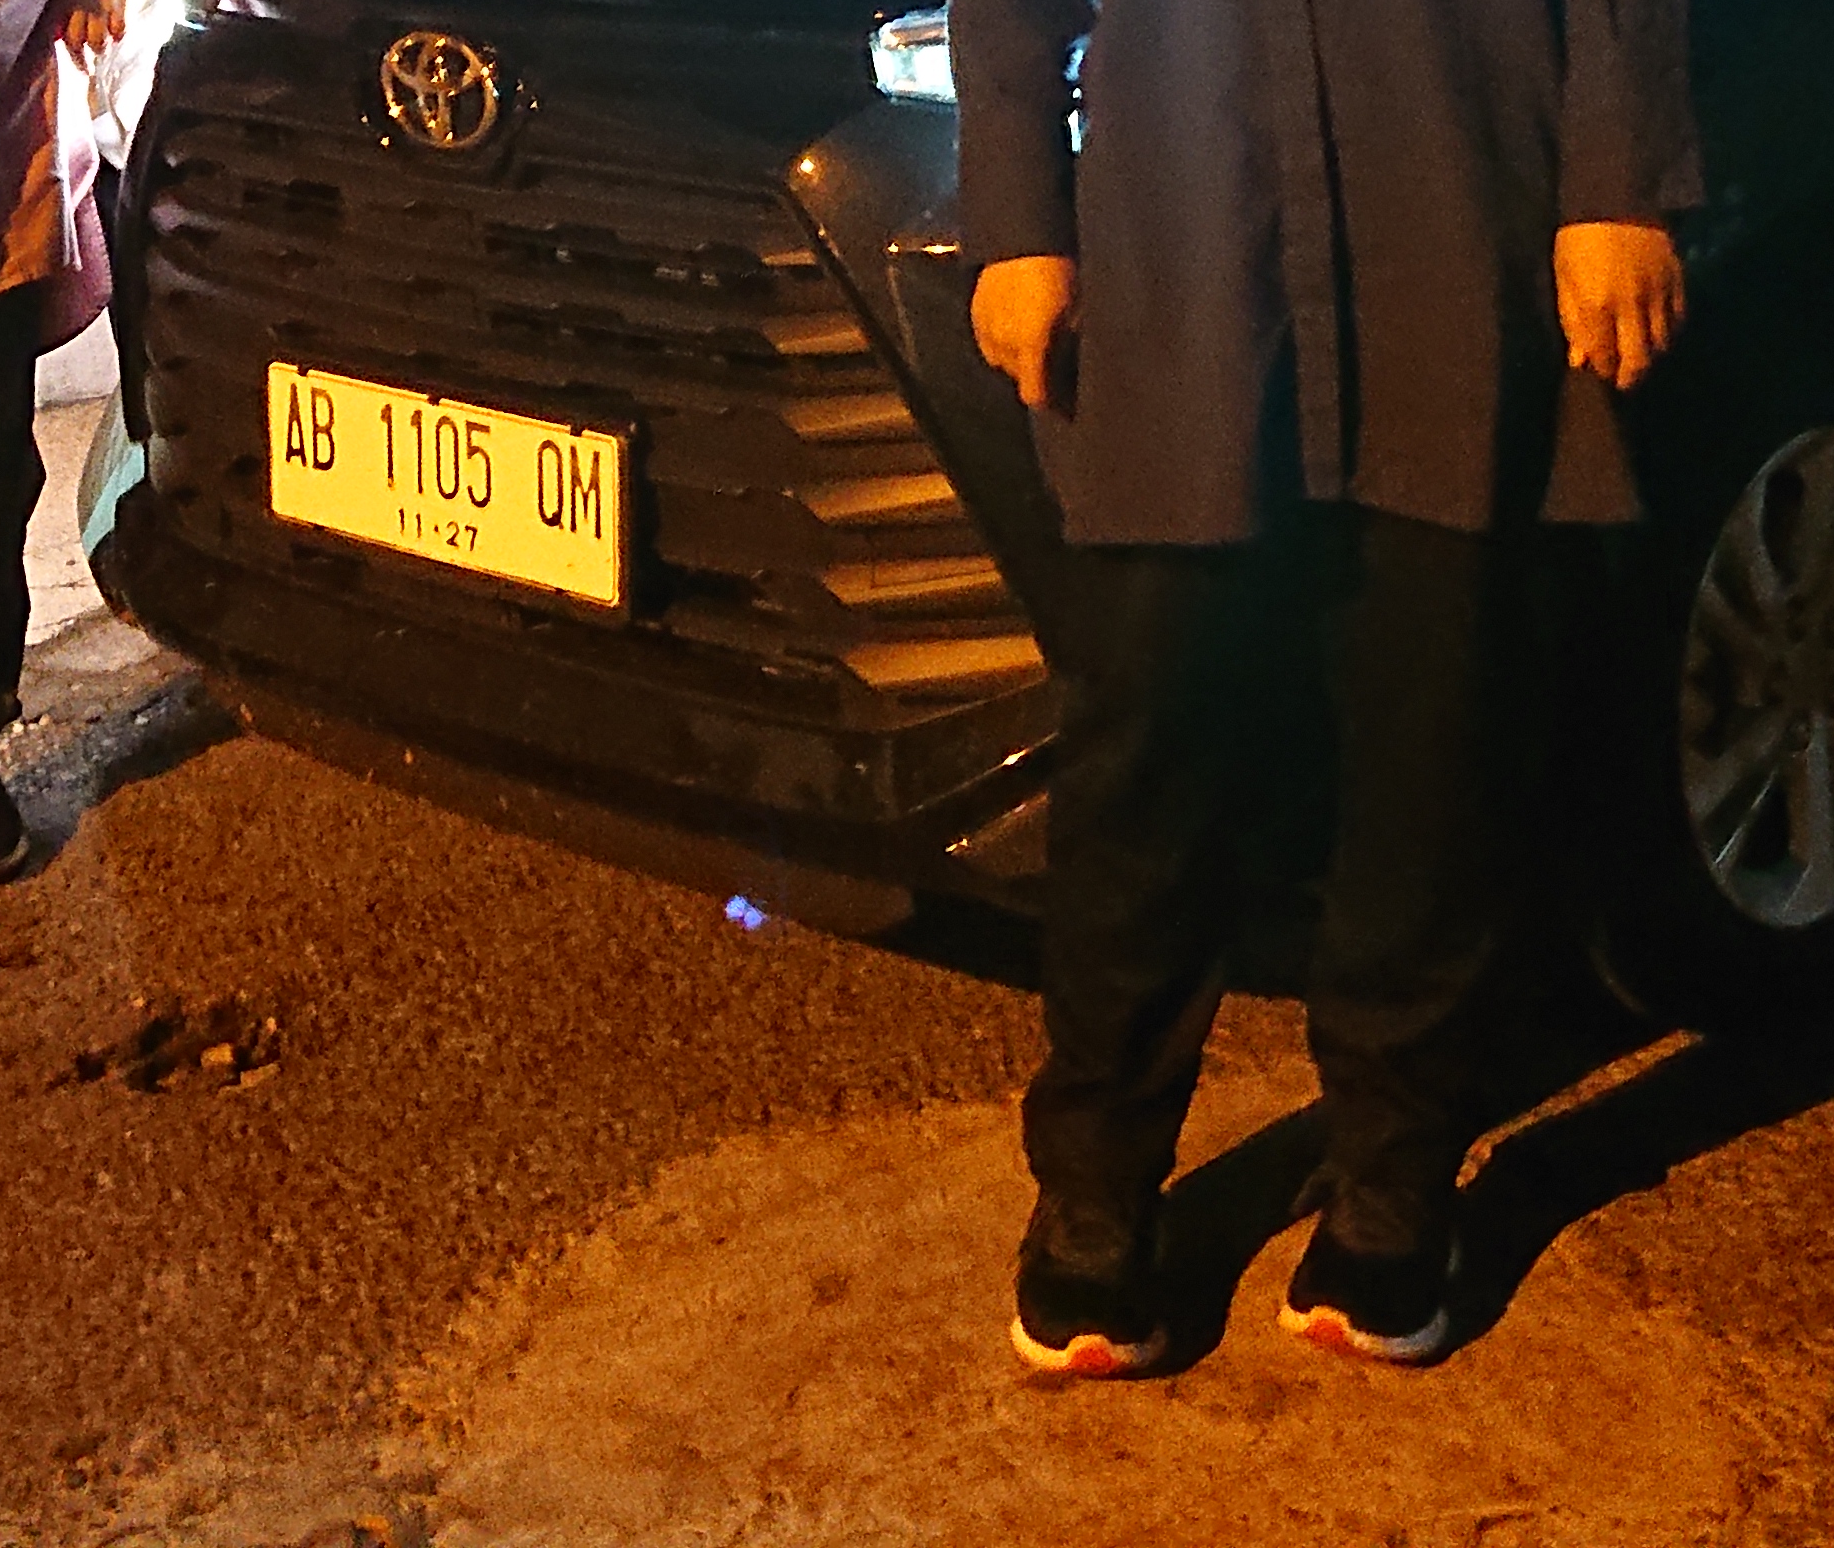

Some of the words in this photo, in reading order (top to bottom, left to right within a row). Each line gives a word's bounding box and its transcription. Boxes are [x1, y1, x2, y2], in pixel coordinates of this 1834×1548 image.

[285, 383, 335, 471] AB
[381, 404, 491, 508] 1105
[537, 440, 602, 539] QM
